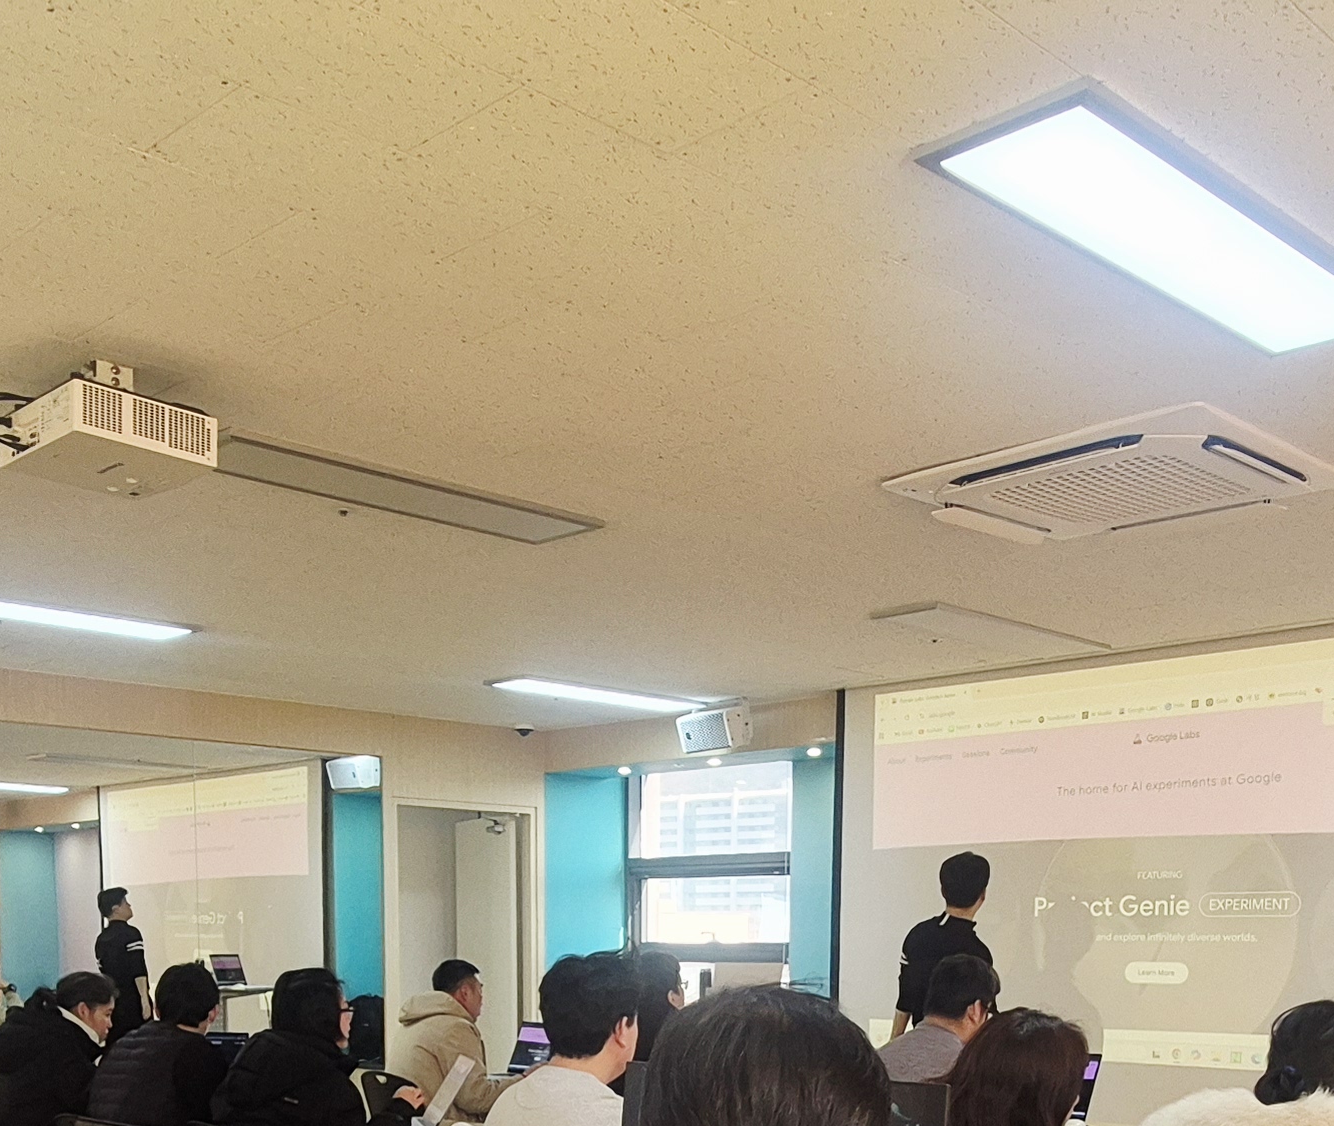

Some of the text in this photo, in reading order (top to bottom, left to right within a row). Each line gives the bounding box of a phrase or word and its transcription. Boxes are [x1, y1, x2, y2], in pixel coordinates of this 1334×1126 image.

[1146, 730, 1201, 744] Google Labs
[1056, 771, 1283, 797] The home for AI experiments at Google
[1136, 870, 1184, 880] FEATURING
[1118, 894, 1191, 917] Genie
[1208, 896, 1292, 912] EXPERIMENT
[1114, 932, 1146, 944] explore
[1147, 931, 1186, 944] infinitely
[1187, 931, 1221, 943] diverse
[1222, 931, 1259, 943] worlds.
[1137, 969, 1175, 977] Learn More
